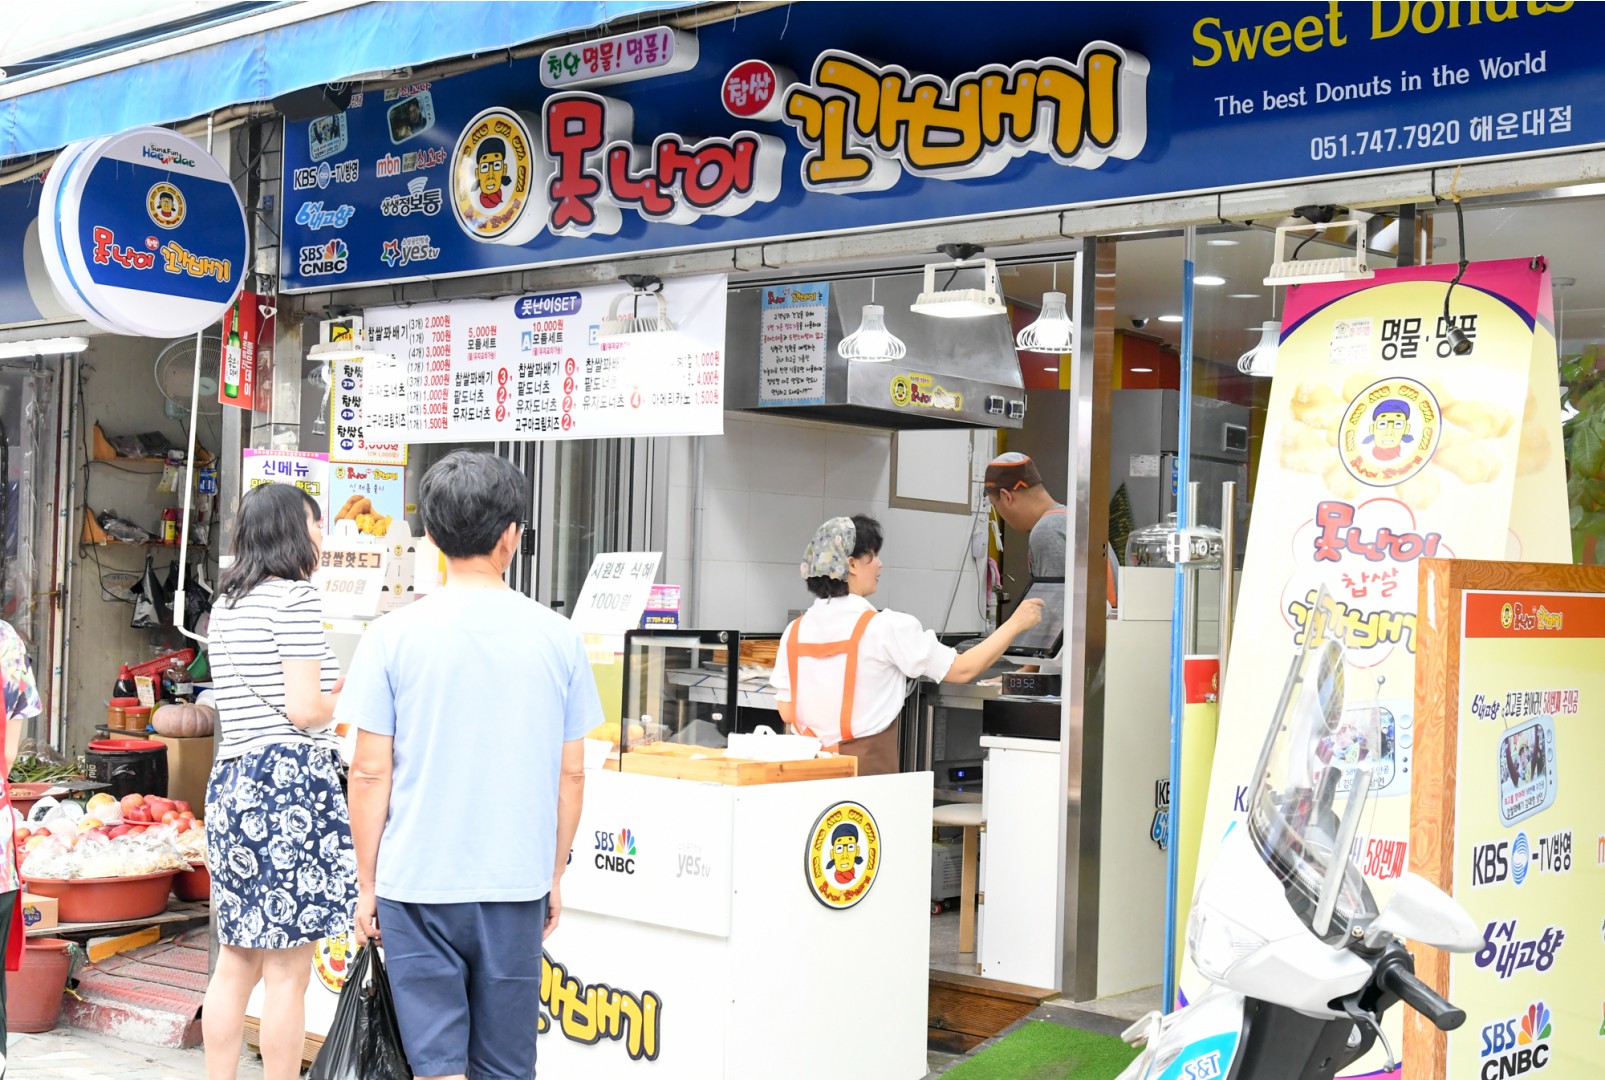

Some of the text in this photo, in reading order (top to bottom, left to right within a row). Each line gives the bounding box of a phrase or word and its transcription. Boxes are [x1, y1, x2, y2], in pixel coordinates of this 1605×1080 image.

[1192, 2, 1348, 67] Sweet
[546, 34, 668, 80] 천안 명물! 명품!
[727, 71, 773, 103] 찹쌀
[1215, 50, 1547, 117] The best Donuts in the World
[545, 48, 1123, 230] 못난이 꽈배기
[1310, 105, 1573, 161] 051.747.7920 해운대점
[377, 153, 401, 178] mbn
[294, 168, 318, 190] KBS
[381, 188, 443, 217] 생생정보통
[308, 204, 356, 231] 내고향
[93, 225, 231, 283] 못난이 꽈배기
[301, 246, 323, 262] SBS
[301, 259, 346, 276] CNBC
[521, 295, 577, 316] 못난이SET
[409, 314, 451, 331] (3개) 2,000원
[468, 325, 497, 339] 5,000원
[533, 320, 564, 333] 10,000원
[367, 325, 409, 342] 찹쌀꽈배기
[409, 333, 425, 346] (1개)
[432, 330, 451, 343] 700원
[1381, 317, 1422, 361] 명물
[425, 344, 451, 358] 3,000원
[426, 359, 450, 373] 1,000원
[518, 360, 560, 378] 찹쌀꽈배기
[423, 373, 450, 387] 3,000원
[455, 370, 493, 388] 찹쌀꽈배기
[517, 380, 551, 397] 팥도너츠
[423, 388, 449, 401] 1,000원
[453, 389, 485, 405] 팥도너츠
[422, 402, 448, 416] 5,000원
[452, 406, 491, 423] 유자도너츠
[516, 398, 558, 415] 유자도너츠
[424, 416, 448, 430] 1,500원
[515, 416, 560, 432] 고구마크림치즈
[262, 460, 310, 478] 신메뉴
[1313, 500, 1442, 563] 못난이
[321, 551, 382, 569] 찹쌀핫도그
[591, 562, 655, 580] 시원한 식혜
[325, 579, 368, 595] 1500원
[1341, 567, 1399, 599] 찹쌀
[590, 593, 632, 612] 1000원
[1478, 700, 1501, 721] 내고향
[1504, 692, 1523, 717] 최고를
[1543, 690, 1562, 715] 58번째
[1562, 689, 1579, 714] 주인공
[594, 830, 615, 852] SBS
[594, 853, 636, 875] CNBC
[1363, 838, 1407, 880] 58번째
[1472, 841, 1509, 886] KBS
[1495, 926, 1566, 979] 내고향
[1480, 1018, 1516, 1058] SBS
[1184, 1052, 1219, 1080] S&T
[1480, 1043, 1549, 1080] CNBC
